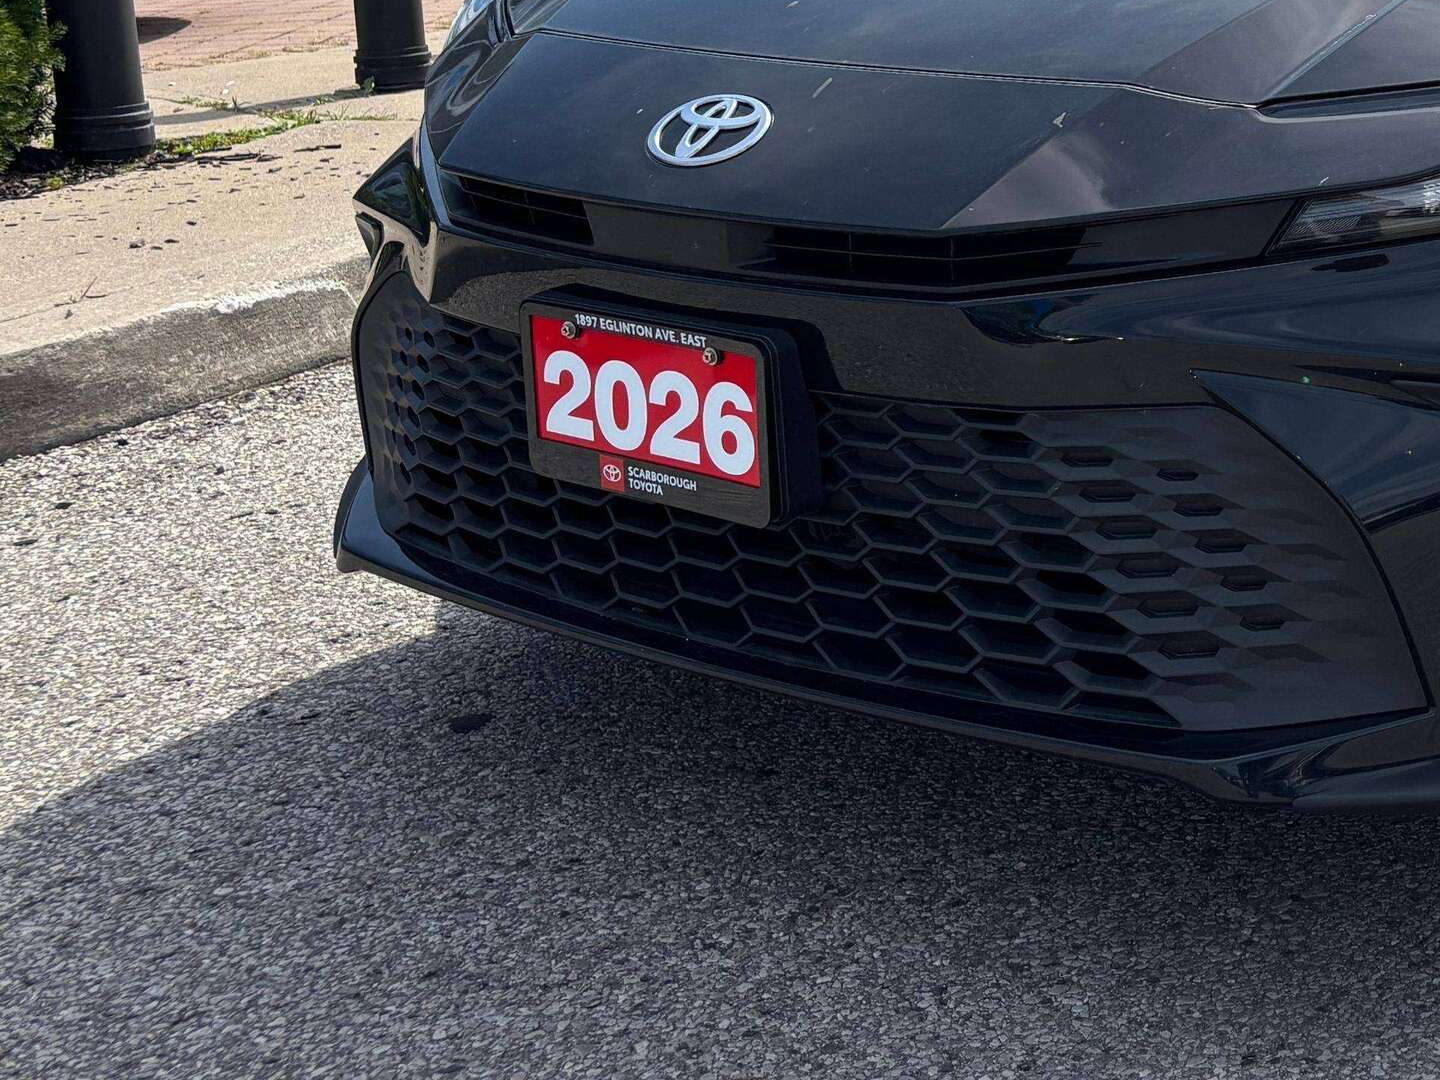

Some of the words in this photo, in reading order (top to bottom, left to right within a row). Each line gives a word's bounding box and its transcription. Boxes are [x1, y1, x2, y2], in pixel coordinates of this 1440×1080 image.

[575, 313, 598, 330] 1897
[599, 317, 653, 339] EGLINTON
[655, 328, 679, 344] AVE.
[680, 332, 707, 348] EAST
[543, 349, 756, 477] 2026
[627, 465, 698, 492] SCARBOROUGH
[628, 478, 664, 497] TOYOTA
